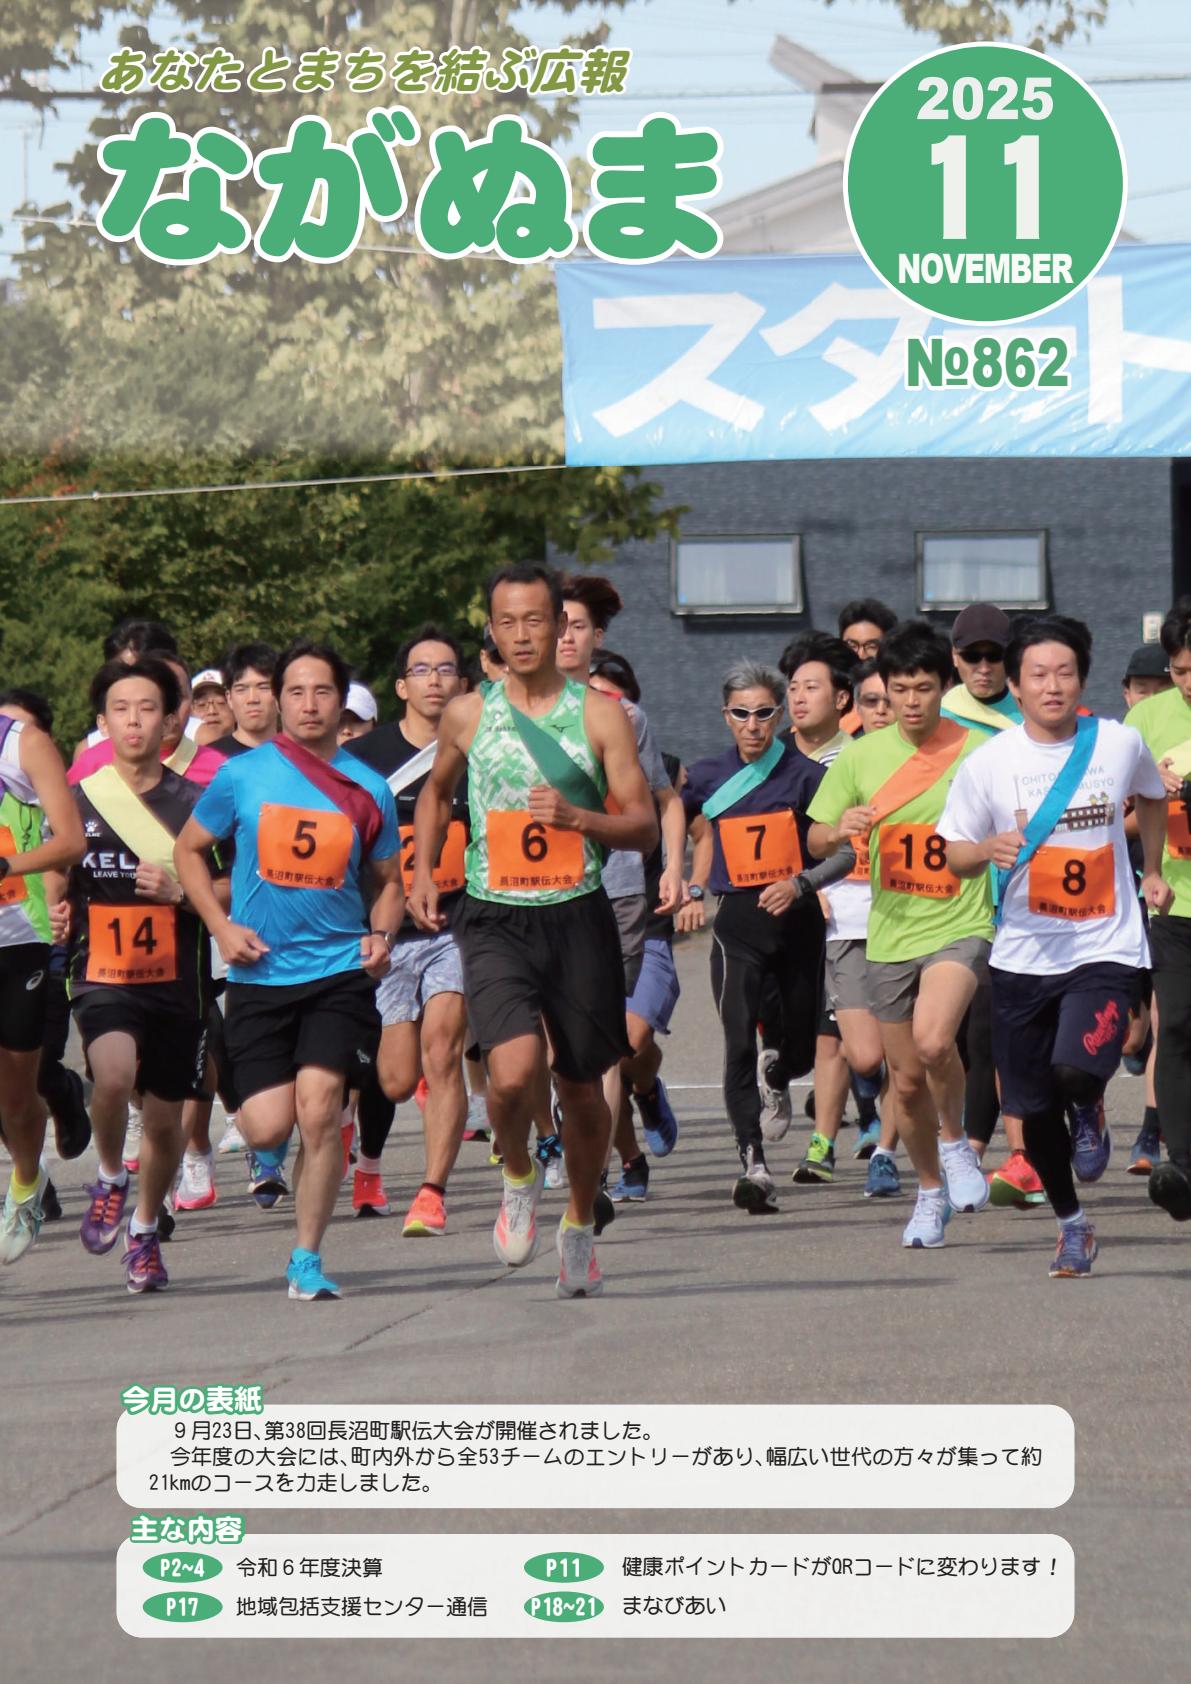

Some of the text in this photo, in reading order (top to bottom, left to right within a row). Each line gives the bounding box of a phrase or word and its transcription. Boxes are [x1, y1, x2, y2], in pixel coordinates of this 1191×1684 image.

[291, 820, 317, 860] 5
[521, 822, 548, 863] 6
[746, 825, 766, 861] 7
[899, 834, 947, 872] 18
[93, 871, 118, 879] LEAVE
[500, 875, 573, 887] 長沼町駅伝大会
[1062, 859, 1086, 896] 8
[1039, 902, 1105, 916] 長沼町駅伝大会
[108, 917, 157, 956] 14
